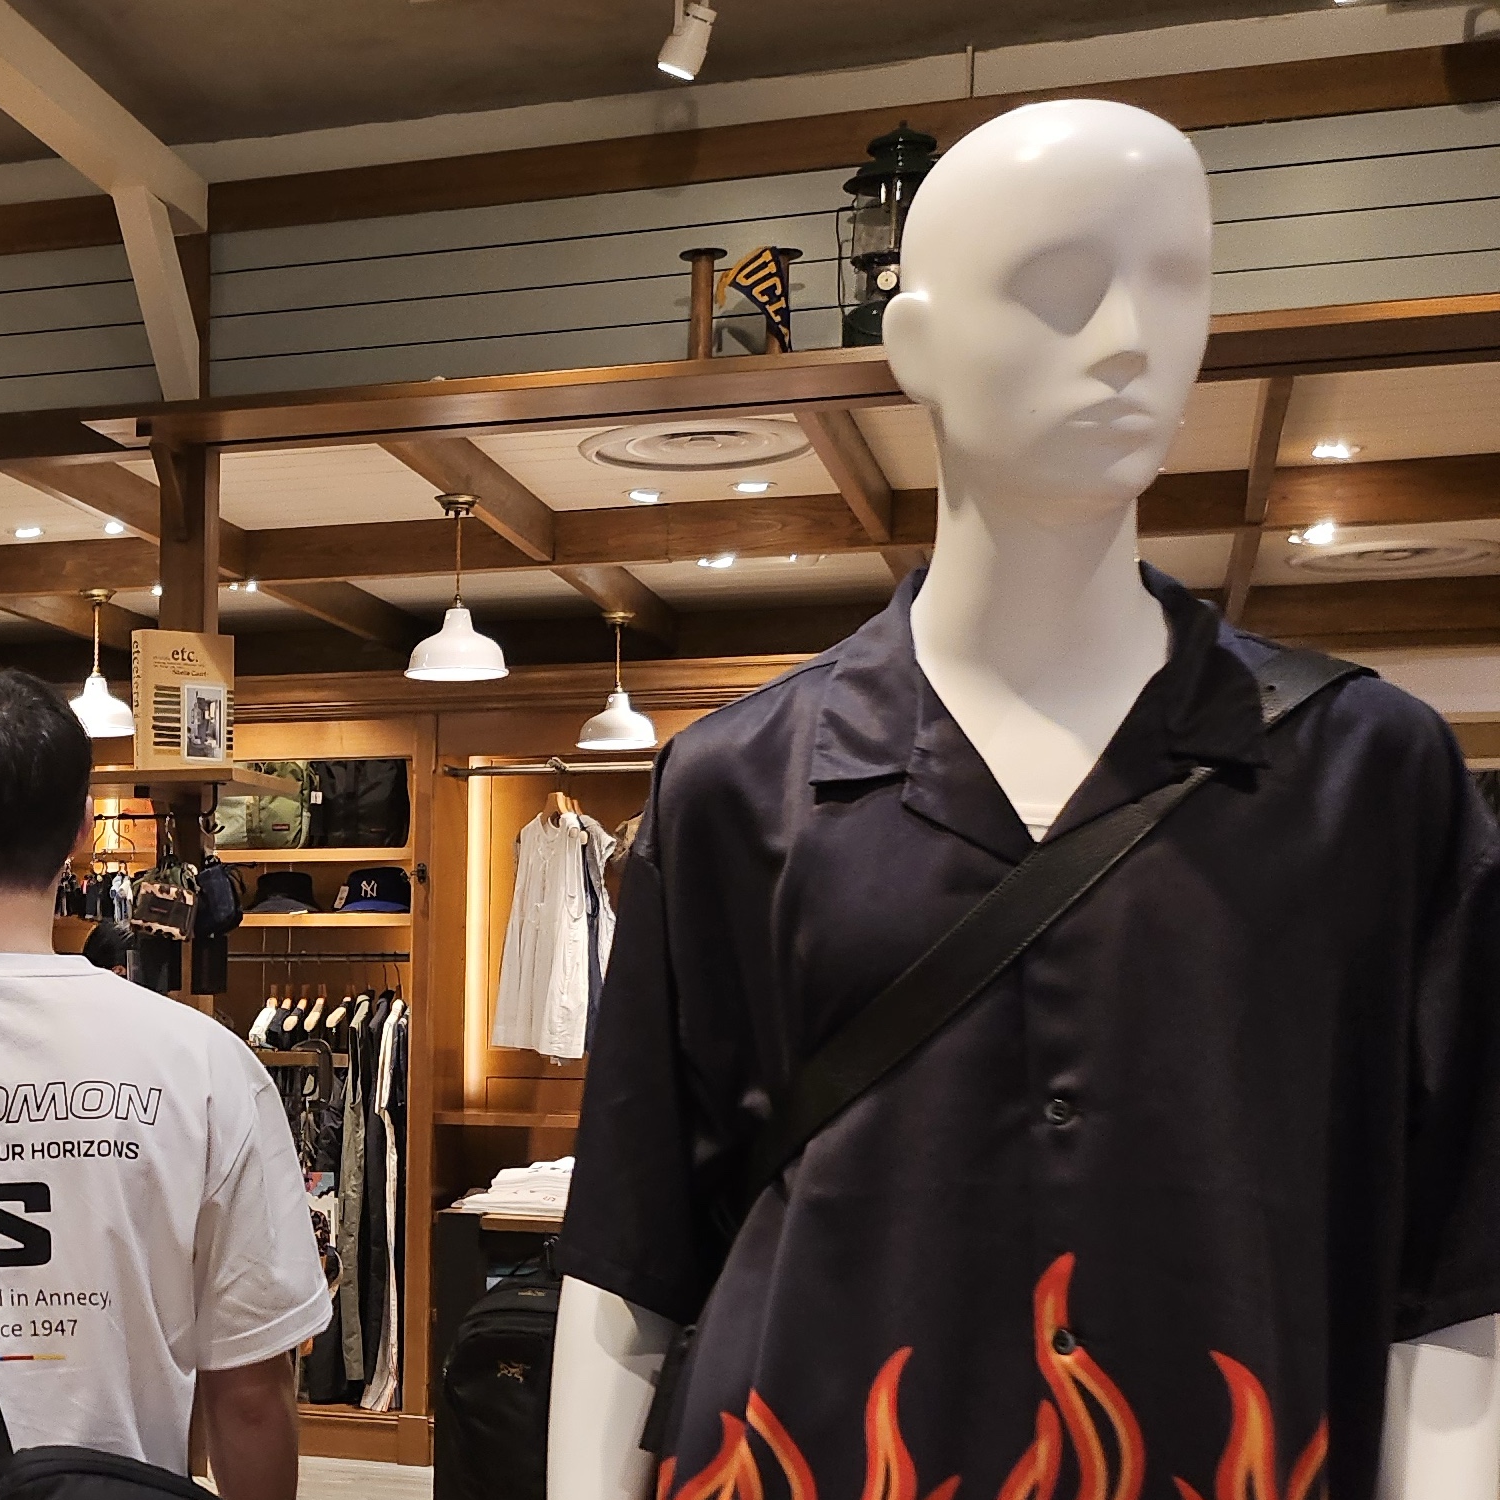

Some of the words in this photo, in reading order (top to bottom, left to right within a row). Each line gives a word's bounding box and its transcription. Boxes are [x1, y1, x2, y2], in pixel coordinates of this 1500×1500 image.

[171, 647, 199, 663] etc.
[31, 1139, 140, 1160] HORIZONS
[10, 1288, 29, 1308] in
[35, 1288, 112, 1309] Annecy,
[30, 1319, 78, 1338] 1947
